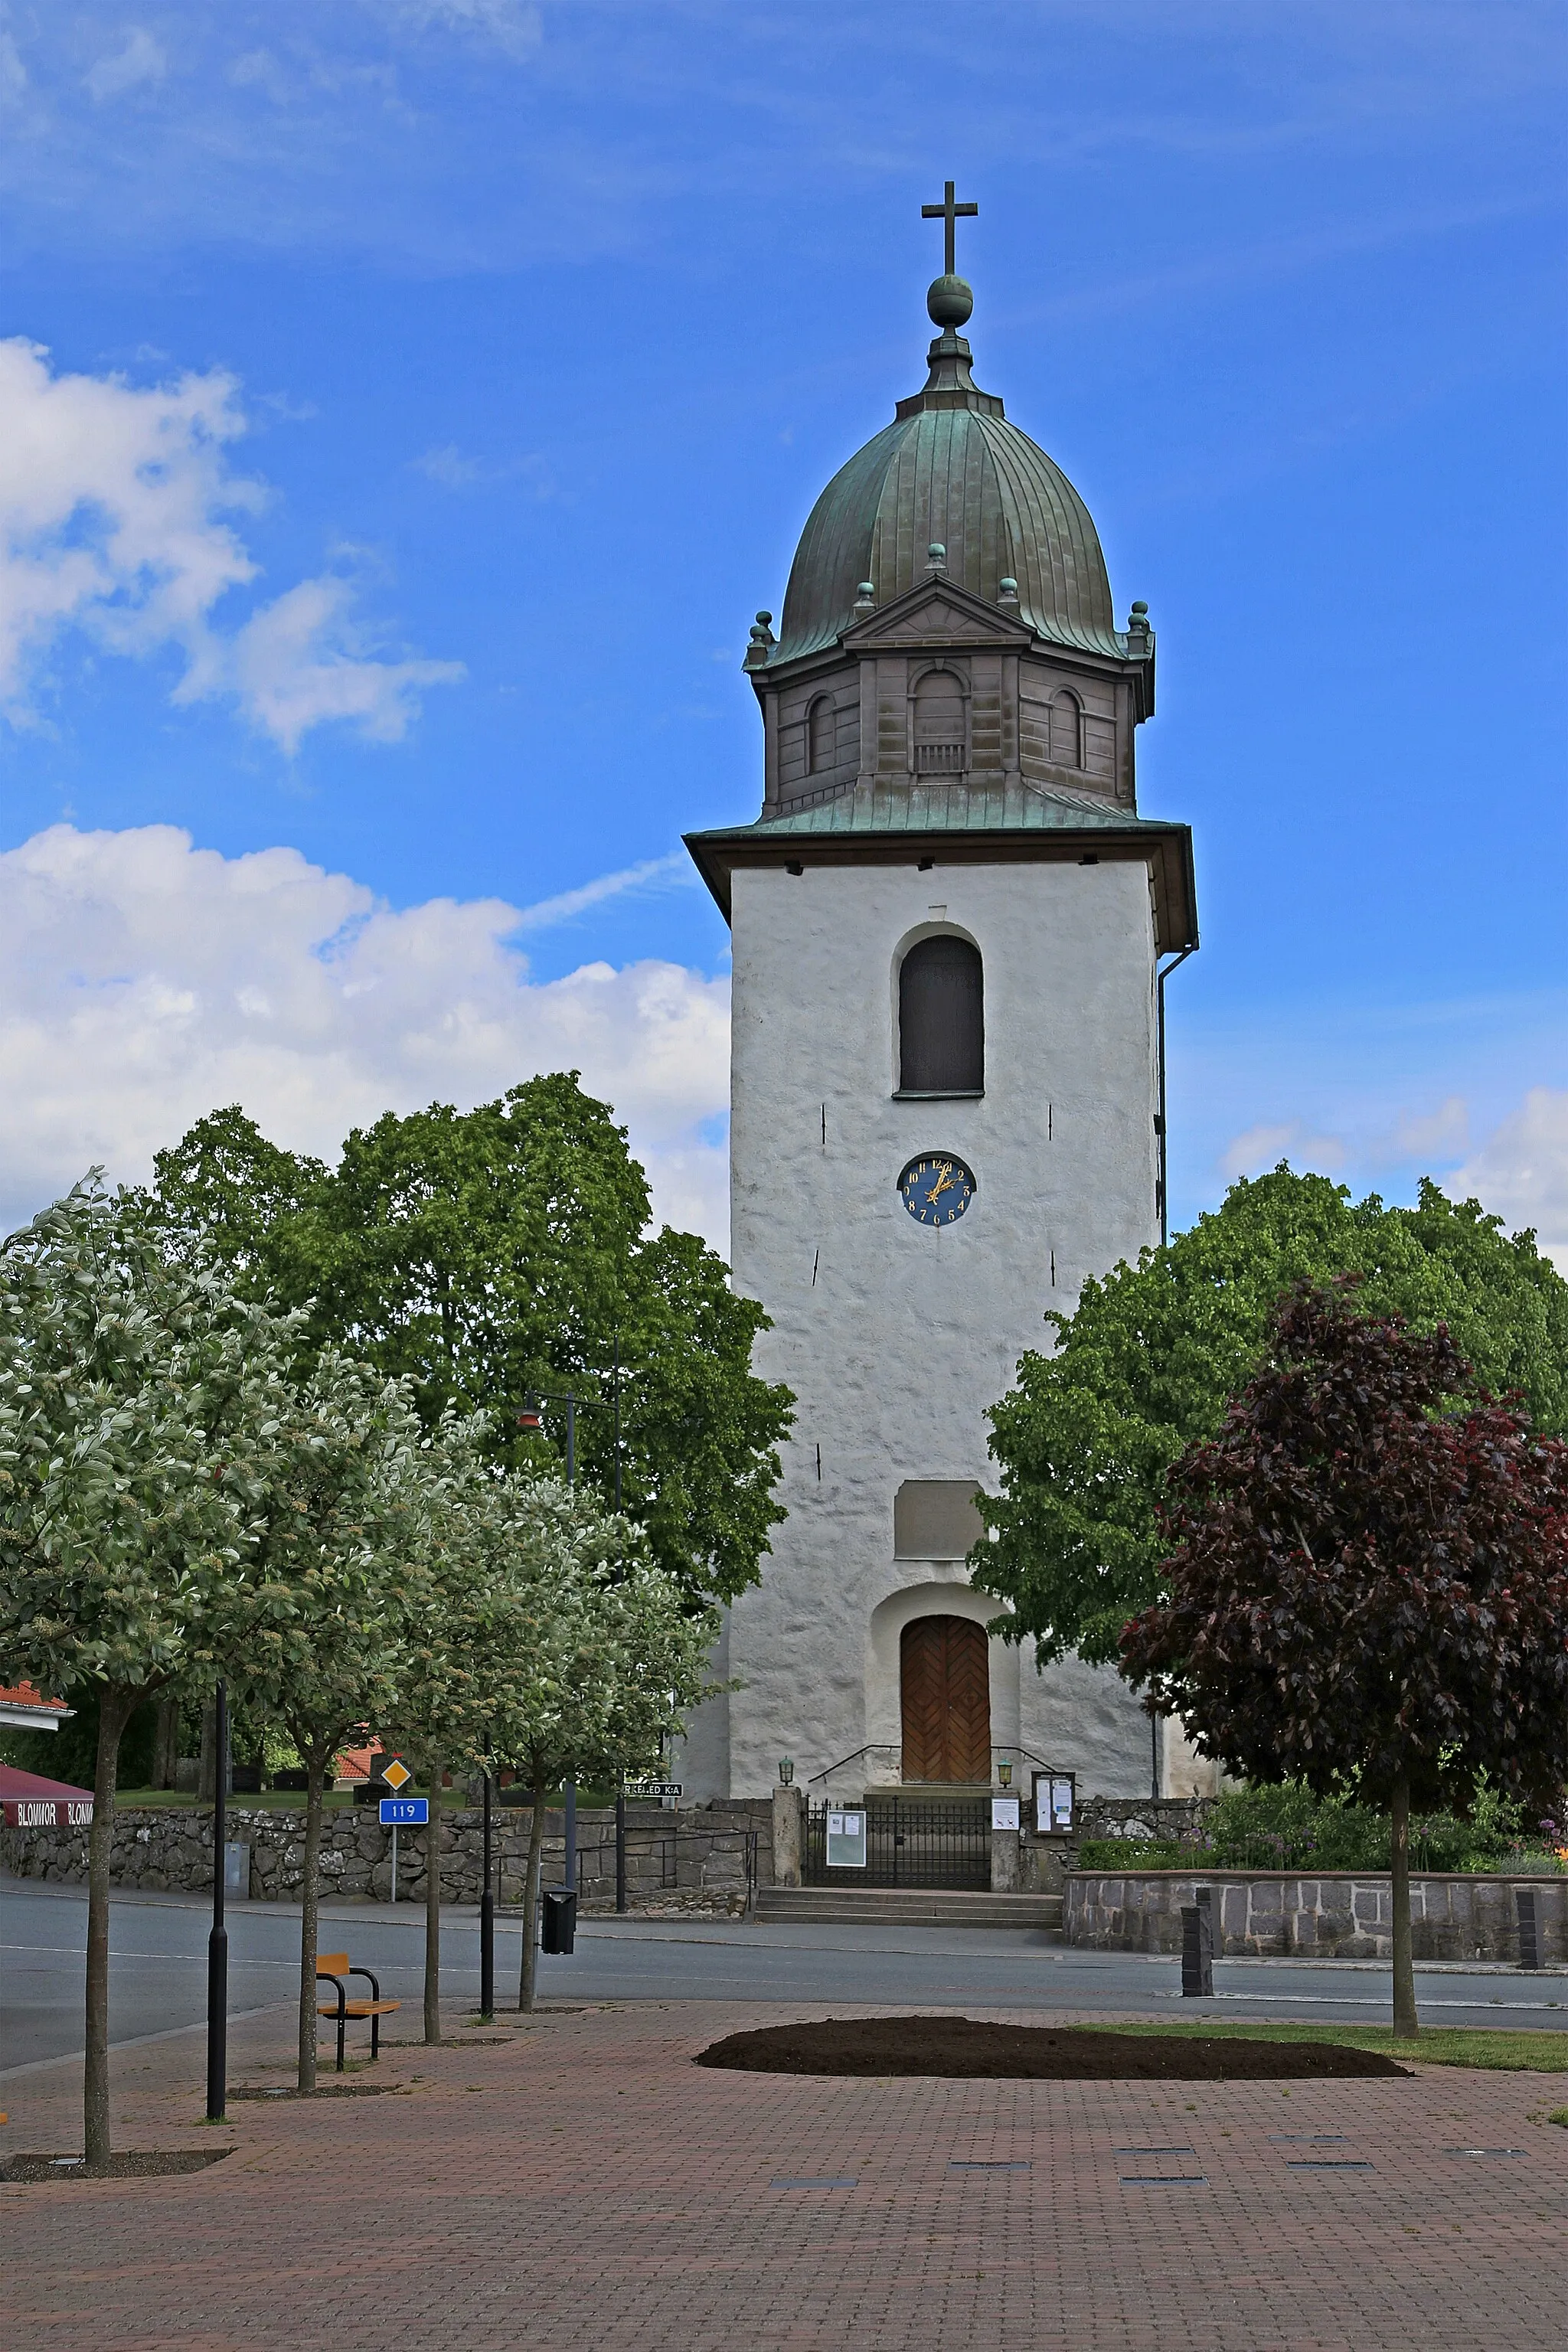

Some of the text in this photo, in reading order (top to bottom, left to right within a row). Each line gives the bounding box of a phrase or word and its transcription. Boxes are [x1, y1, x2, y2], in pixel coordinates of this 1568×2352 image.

[920, 1162, 926, 1173] 11
[933, 1160, 942, 1169] 12
[910, 1173, 918, 1183] 10
[958, 1171, 964, 1181] 2
[904, 1187, 910, 1196] 9
[964, 1187, 969, 1196] 3
[909, 1201, 915, 1210] 8
[958, 1200, 964, 1210] 4
[920, 1210, 926, 1220] 7
[934, 1215, 939, 1224] 6
[949, 1210, 955, 1220] 5
[18, 1803, 93, 1826] BLOMMOR BLOMM
[393, 1805, 415, 1817] 119
